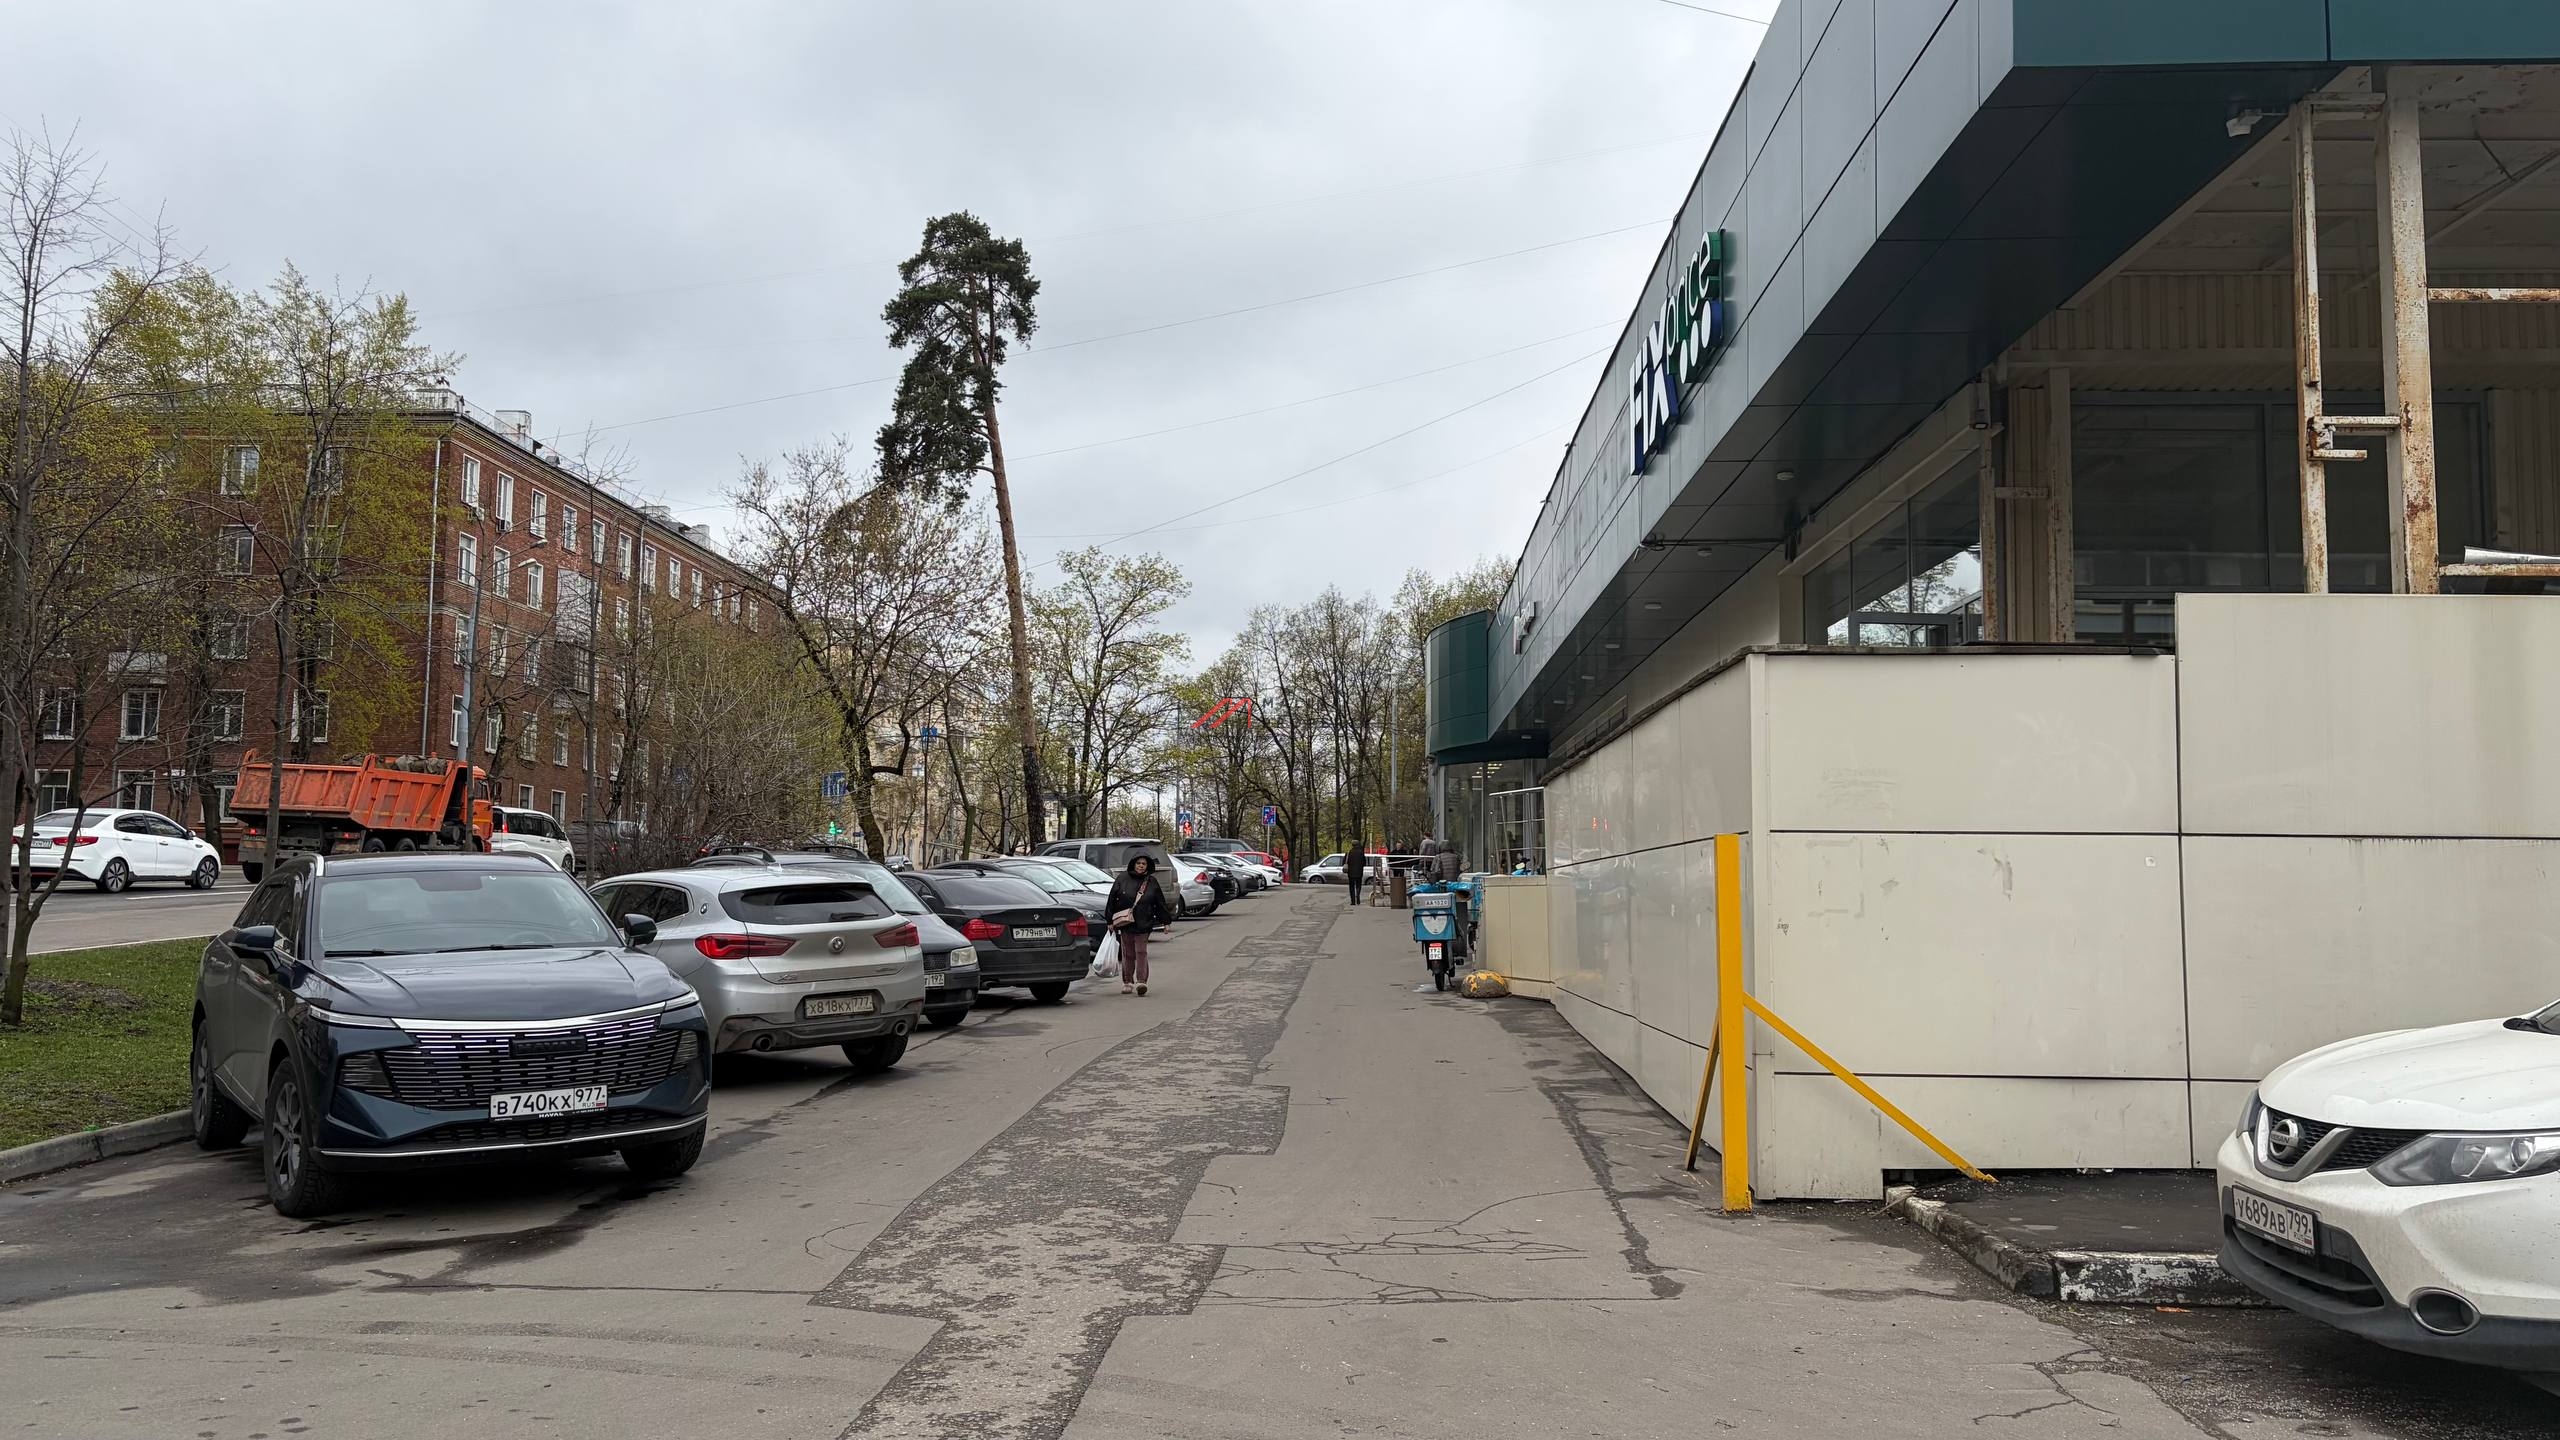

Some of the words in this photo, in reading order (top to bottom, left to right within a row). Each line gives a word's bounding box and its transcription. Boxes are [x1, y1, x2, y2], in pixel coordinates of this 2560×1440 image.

[498, 1094, 572, 1115] В740КХ
[576, 1087, 602, 1102] 977
[2237, 1197, 2285, 1234] У689АВ
[2288, 1210, 2308, 1235] 799
